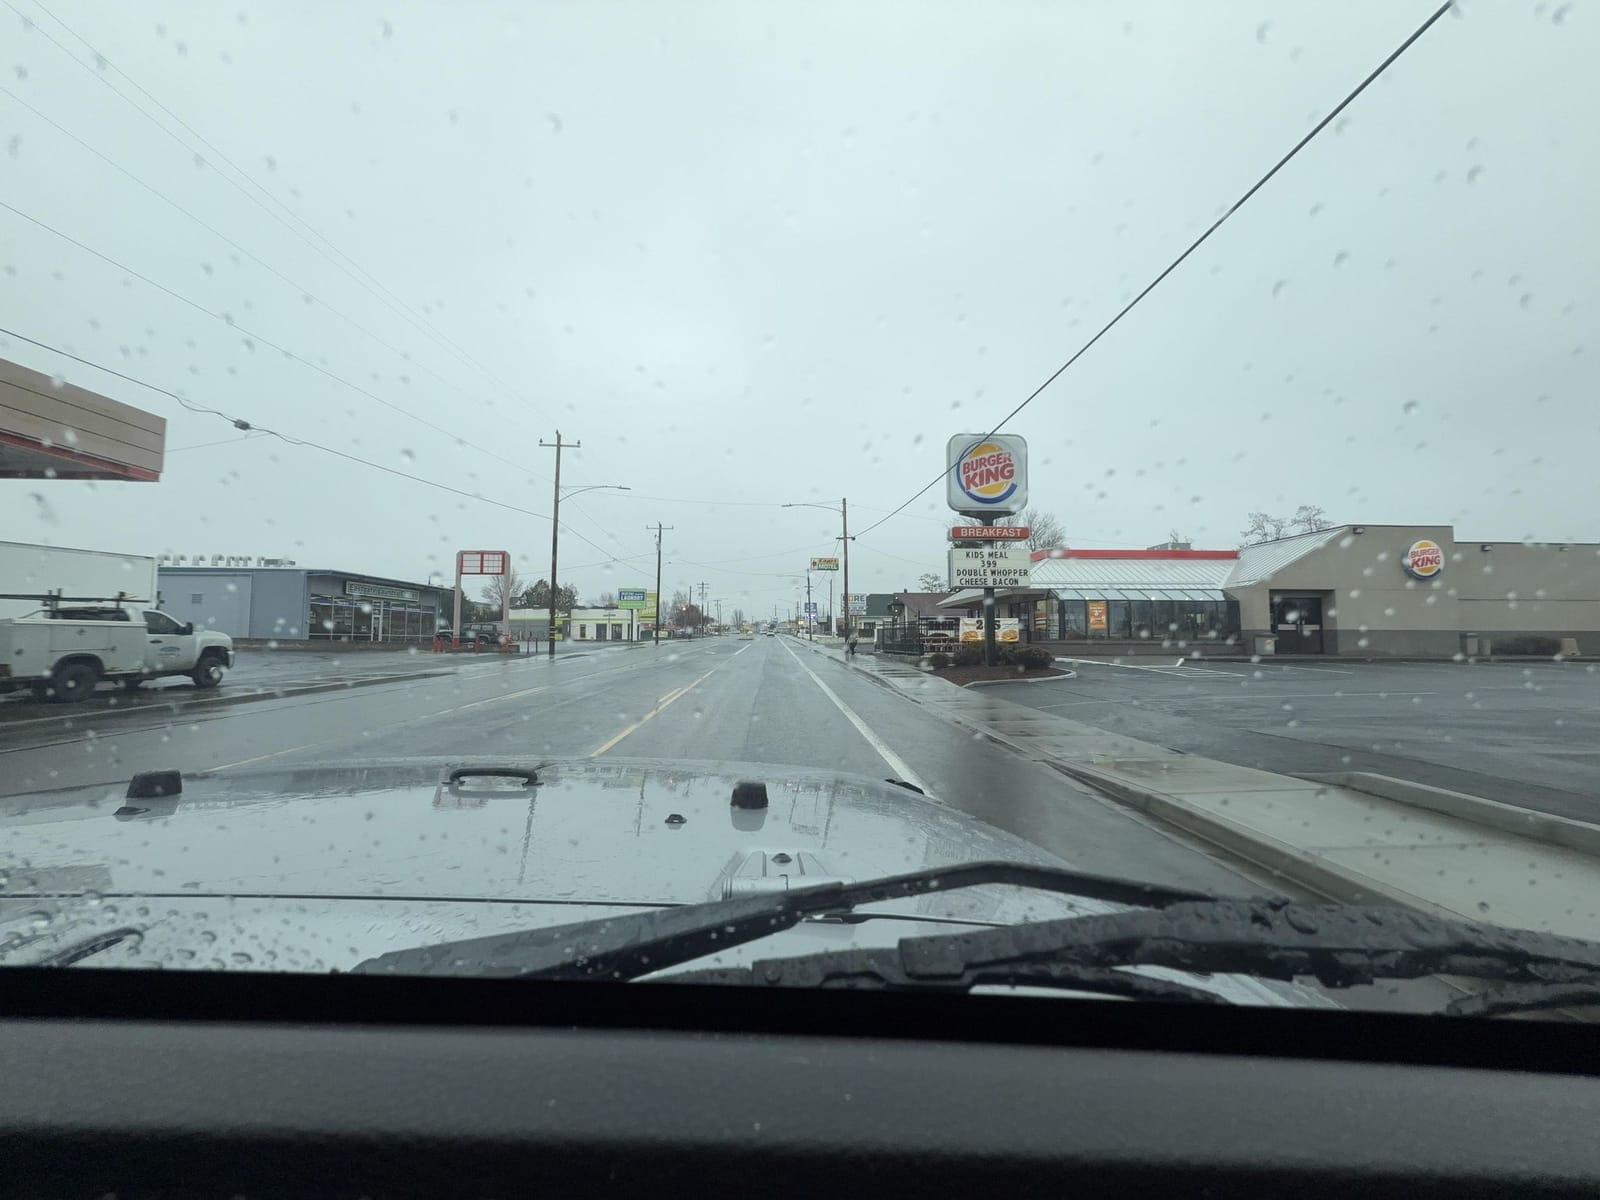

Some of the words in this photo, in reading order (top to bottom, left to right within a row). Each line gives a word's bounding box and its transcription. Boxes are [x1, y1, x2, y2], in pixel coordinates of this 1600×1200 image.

[962, 451, 1012, 475] BURGER
[964, 462, 1015, 491] KING
[960, 528, 1022, 537] BREAKFAST
[965, 551, 985, 559] KIDS
[988, 551, 1009, 559] MEAL
[1410, 549, 1440, 558] BURGER
[980, 560, 997, 568] 399
[1411, 555, 1440, 568] KING
[956, 569, 988, 577] DOUBLE
[990, 569, 1029, 577] WHOPPER
[959, 577, 988, 586] CHEESE
[992, 577, 1019, 586] BACON
